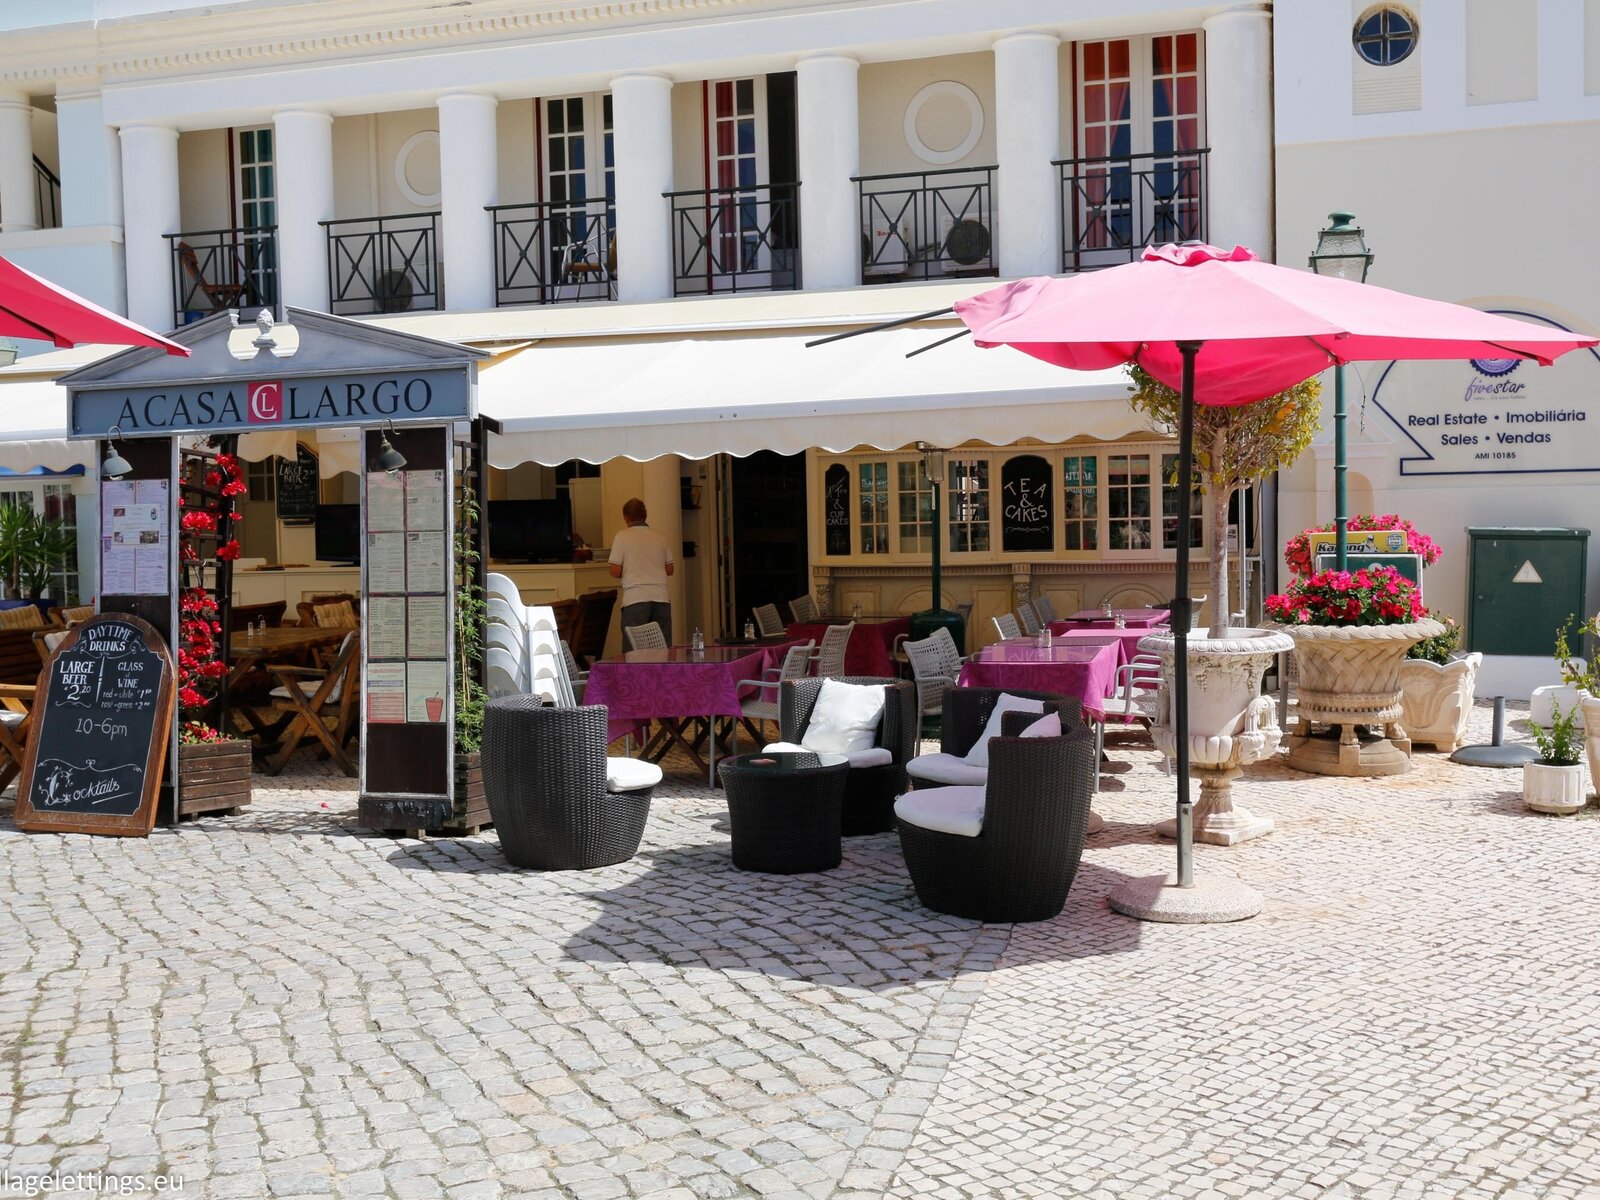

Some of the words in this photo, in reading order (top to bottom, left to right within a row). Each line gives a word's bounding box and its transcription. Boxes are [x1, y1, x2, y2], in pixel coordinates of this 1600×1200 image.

[1464, 376, 1526, 402] fivestar
[288, 378, 432, 420] LARGO
[1408, 414, 1439, 426] Real
[1444, 413, 1488, 426] Estate
[1506, 409, 1586, 424] Imobiliária
[1441, 433, 1479, 446] Sales
[1496, 431, 1551, 444] Vendas
[1475, 452, 1490, 460] AMI
[1492, 452, 1516, 460] 10185
[1004, 478, 1047, 498] TEA
[1020, 493, 1034, 508] &
[829, 510, 845, 518] CUP
[1005, 504, 1048, 522] CAKES
[826, 518, 849, 526] CAKES
[1317, 543, 1366, 553] Kang
[88, 624, 134, 641] DAYTIME
[89, 640, 126, 651] DRINKS
[60, 660, 96, 673] LARGE
[117, 661, 144, 671] GLASS
[62, 674, 87, 684] BEER
[117, 678, 139, 688] WINE
[102, 688, 114, 698] red
[75, 718, 128, 740] 10-6pm
